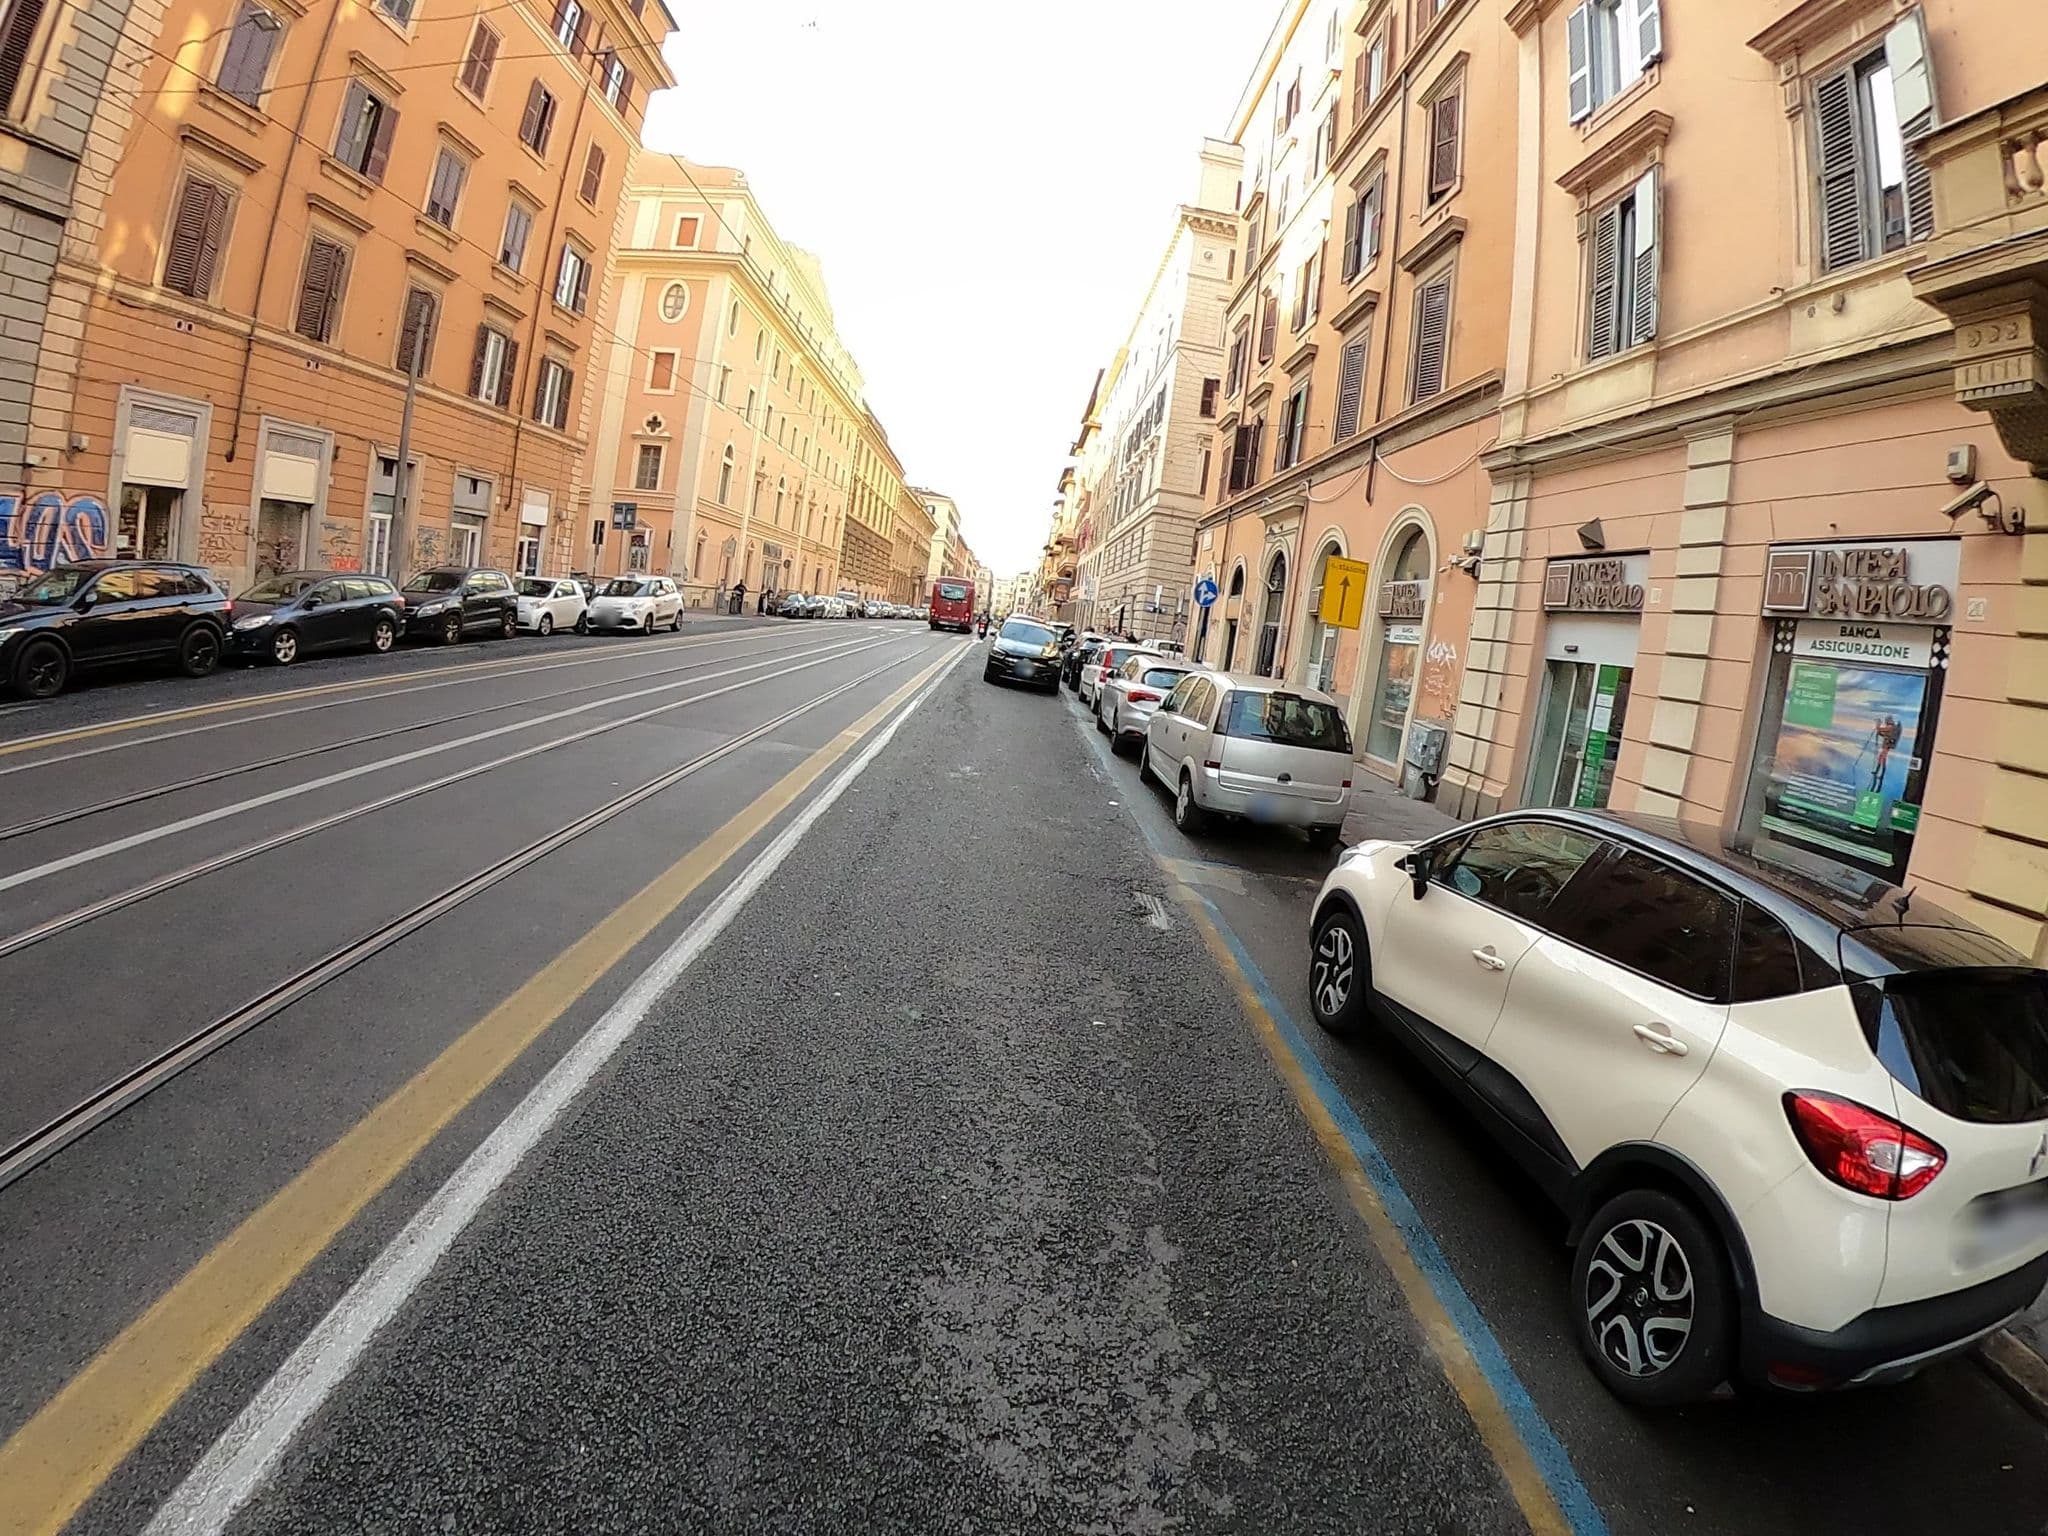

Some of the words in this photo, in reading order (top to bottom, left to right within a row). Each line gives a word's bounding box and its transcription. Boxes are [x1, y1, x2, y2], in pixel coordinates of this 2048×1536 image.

[1573, 560, 1625, 582] INTESA
[1818, 548, 1909, 581] INTESA
[1570, 584, 1645, 609] SANPAOLO
[1815, 582, 1952, 619] SANPAOLO
[1839, 625, 1881, 640] BANCA
[1810, 639, 1911, 660] ASSICURAZIONE
